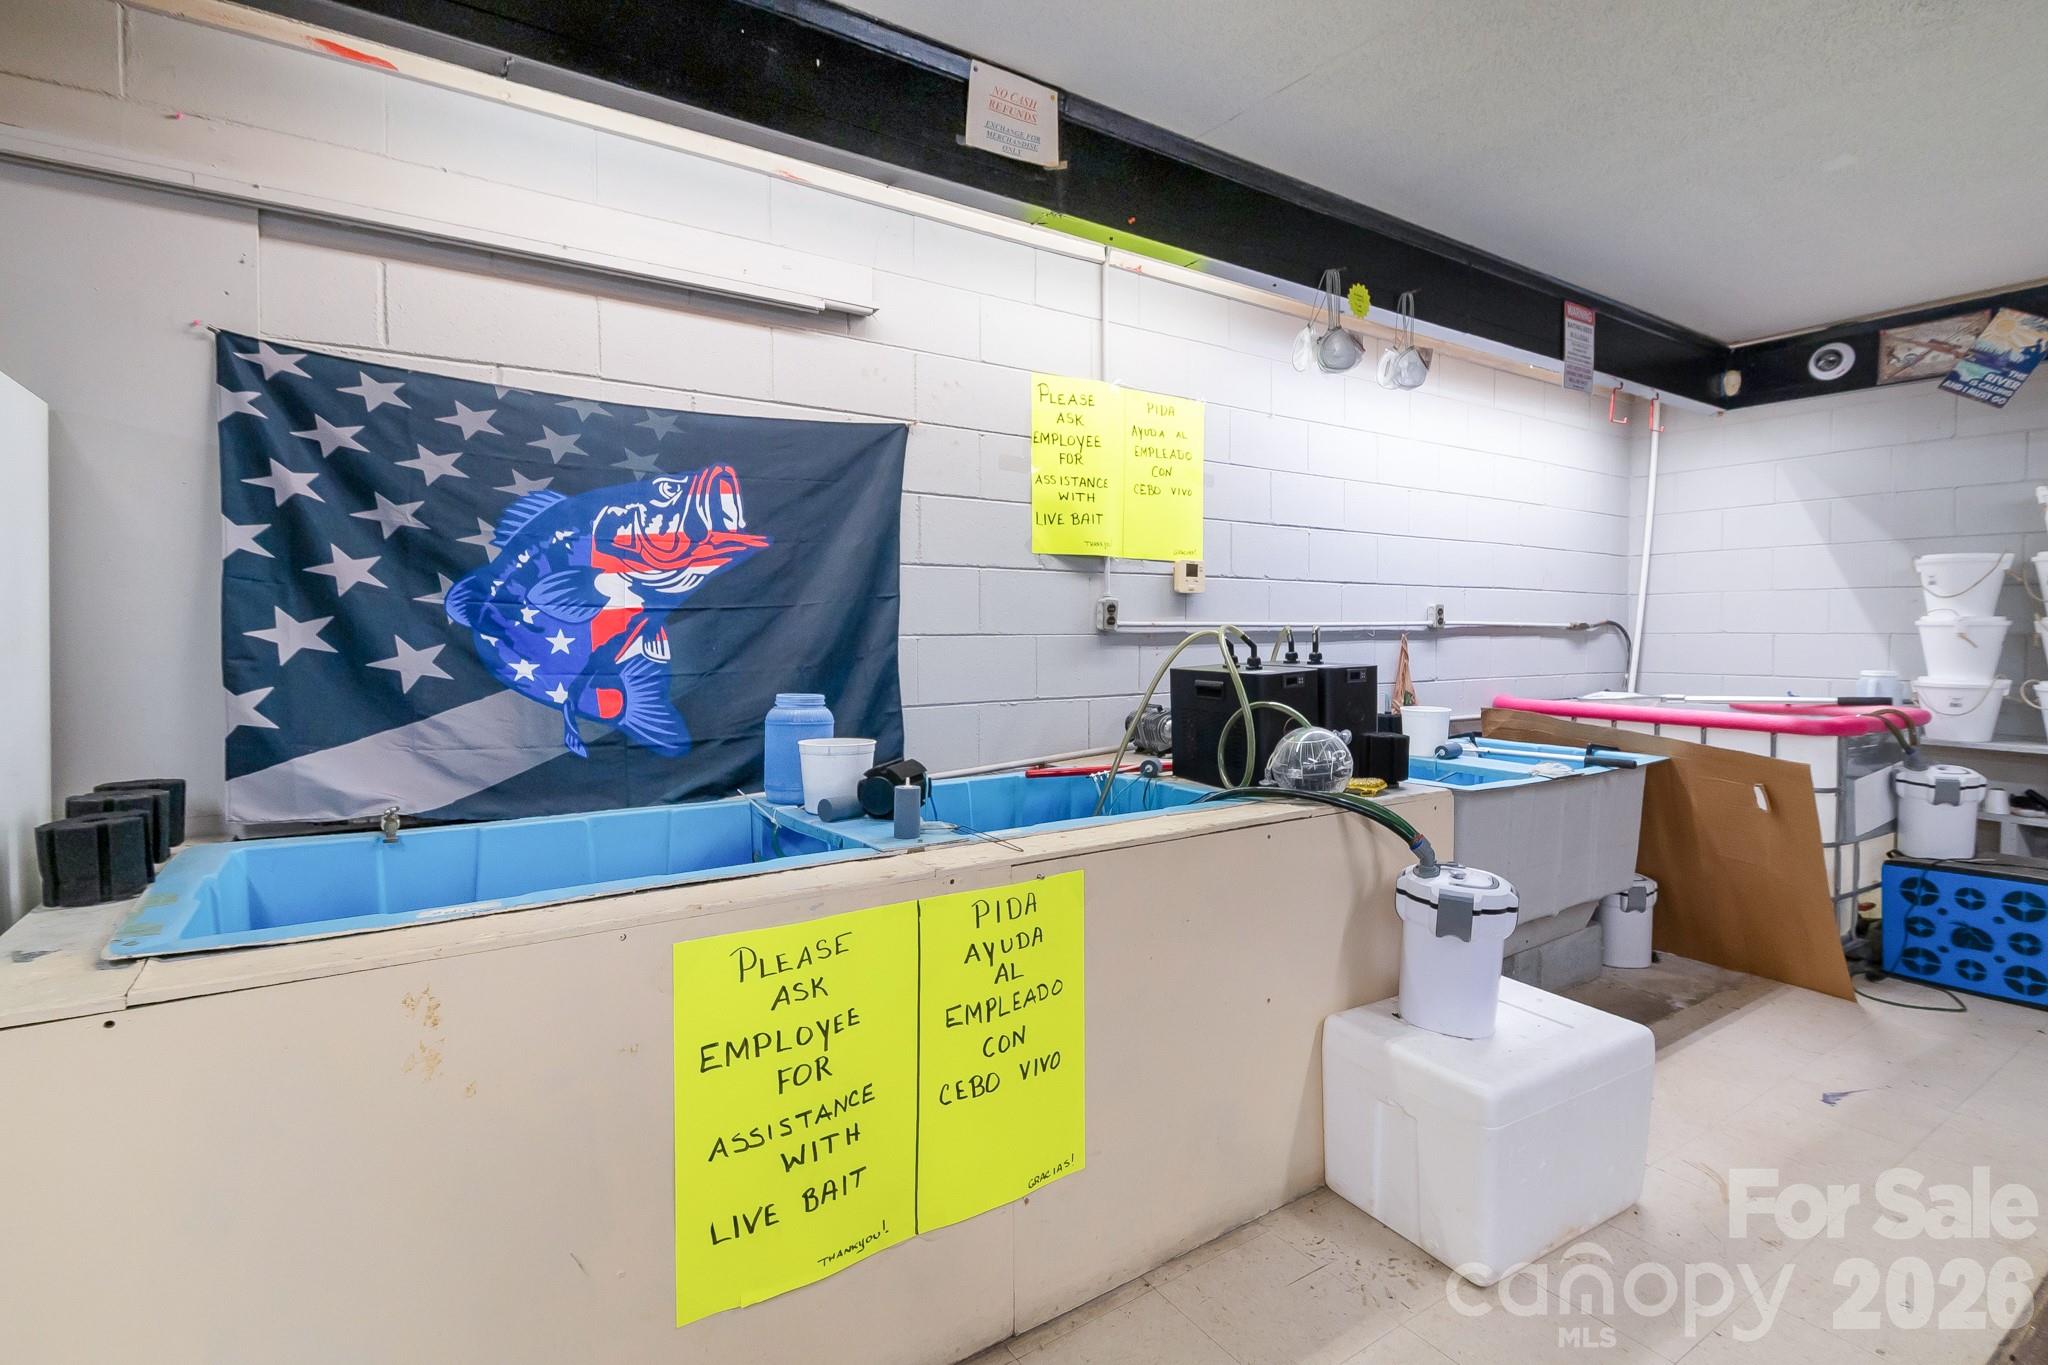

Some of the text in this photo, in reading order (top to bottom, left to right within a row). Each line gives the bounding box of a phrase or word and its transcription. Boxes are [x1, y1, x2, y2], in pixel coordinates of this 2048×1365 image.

[991, 86, 1038, 110] NO CASH
[989, 99, 1038, 124] REFUNDS
[985, 120, 1041, 143] EXCHANGE FOR
[986, 130, 1040, 151] MERCHANDISE
[1002, 146, 1023, 156] ONLY
[1984, 373, 2022, 391] RIVER
[2008, 370, 2028, 380] THE
[1037, 382, 1095, 407] PLEASE
[1942, 380, 1963, 390] AND
[1967, 387, 1993, 399] MUST
[1969, 379, 2014, 397] IS CALLING
[1056, 412, 1084, 426] ASK
[1146, 402, 1175, 417] PIDA
[1033, 430, 1102, 453] EMPLOYEE
[1131, 424, 1188, 441] AYUDA AL
[1059, 452, 1084, 465] FOR
[1134, 445, 1193, 461] EMPLEADO
[1035, 475, 1108, 489] ASSISTANCE
[1151, 465, 1173, 478] CON
[1058, 491, 1095, 503] WITH
[1133, 483, 1193, 497] CEBO VIVO
[1035, 511, 1104, 526] LIVE BAIT
[971, 892, 1039, 929] PIDA
[729, 931, 854, 984] PLEASE
[964, 926, 1044, 968] AYUDA
[993, 963, 1025, 985] AL
[771, 977, 830, 1011] ASK
[945, 979, 1065, 1029] EMPLEADO
[699, 1007, 861, 1073] EMPLOYEE
[982, 1025, 1027, 1058] CON
[777, 1055, 833, 1095] FOR
[938, 1050, 1062, 1107] CEBO VIVO
[708, 1083, 876, 1163] ASSISTANCE
[780, 1122, 861, 1173] WITH
[1027, 1153, 1076, 1190] GRACIAS!
[710, 1166, 868, 1246] LIVE BAIT
